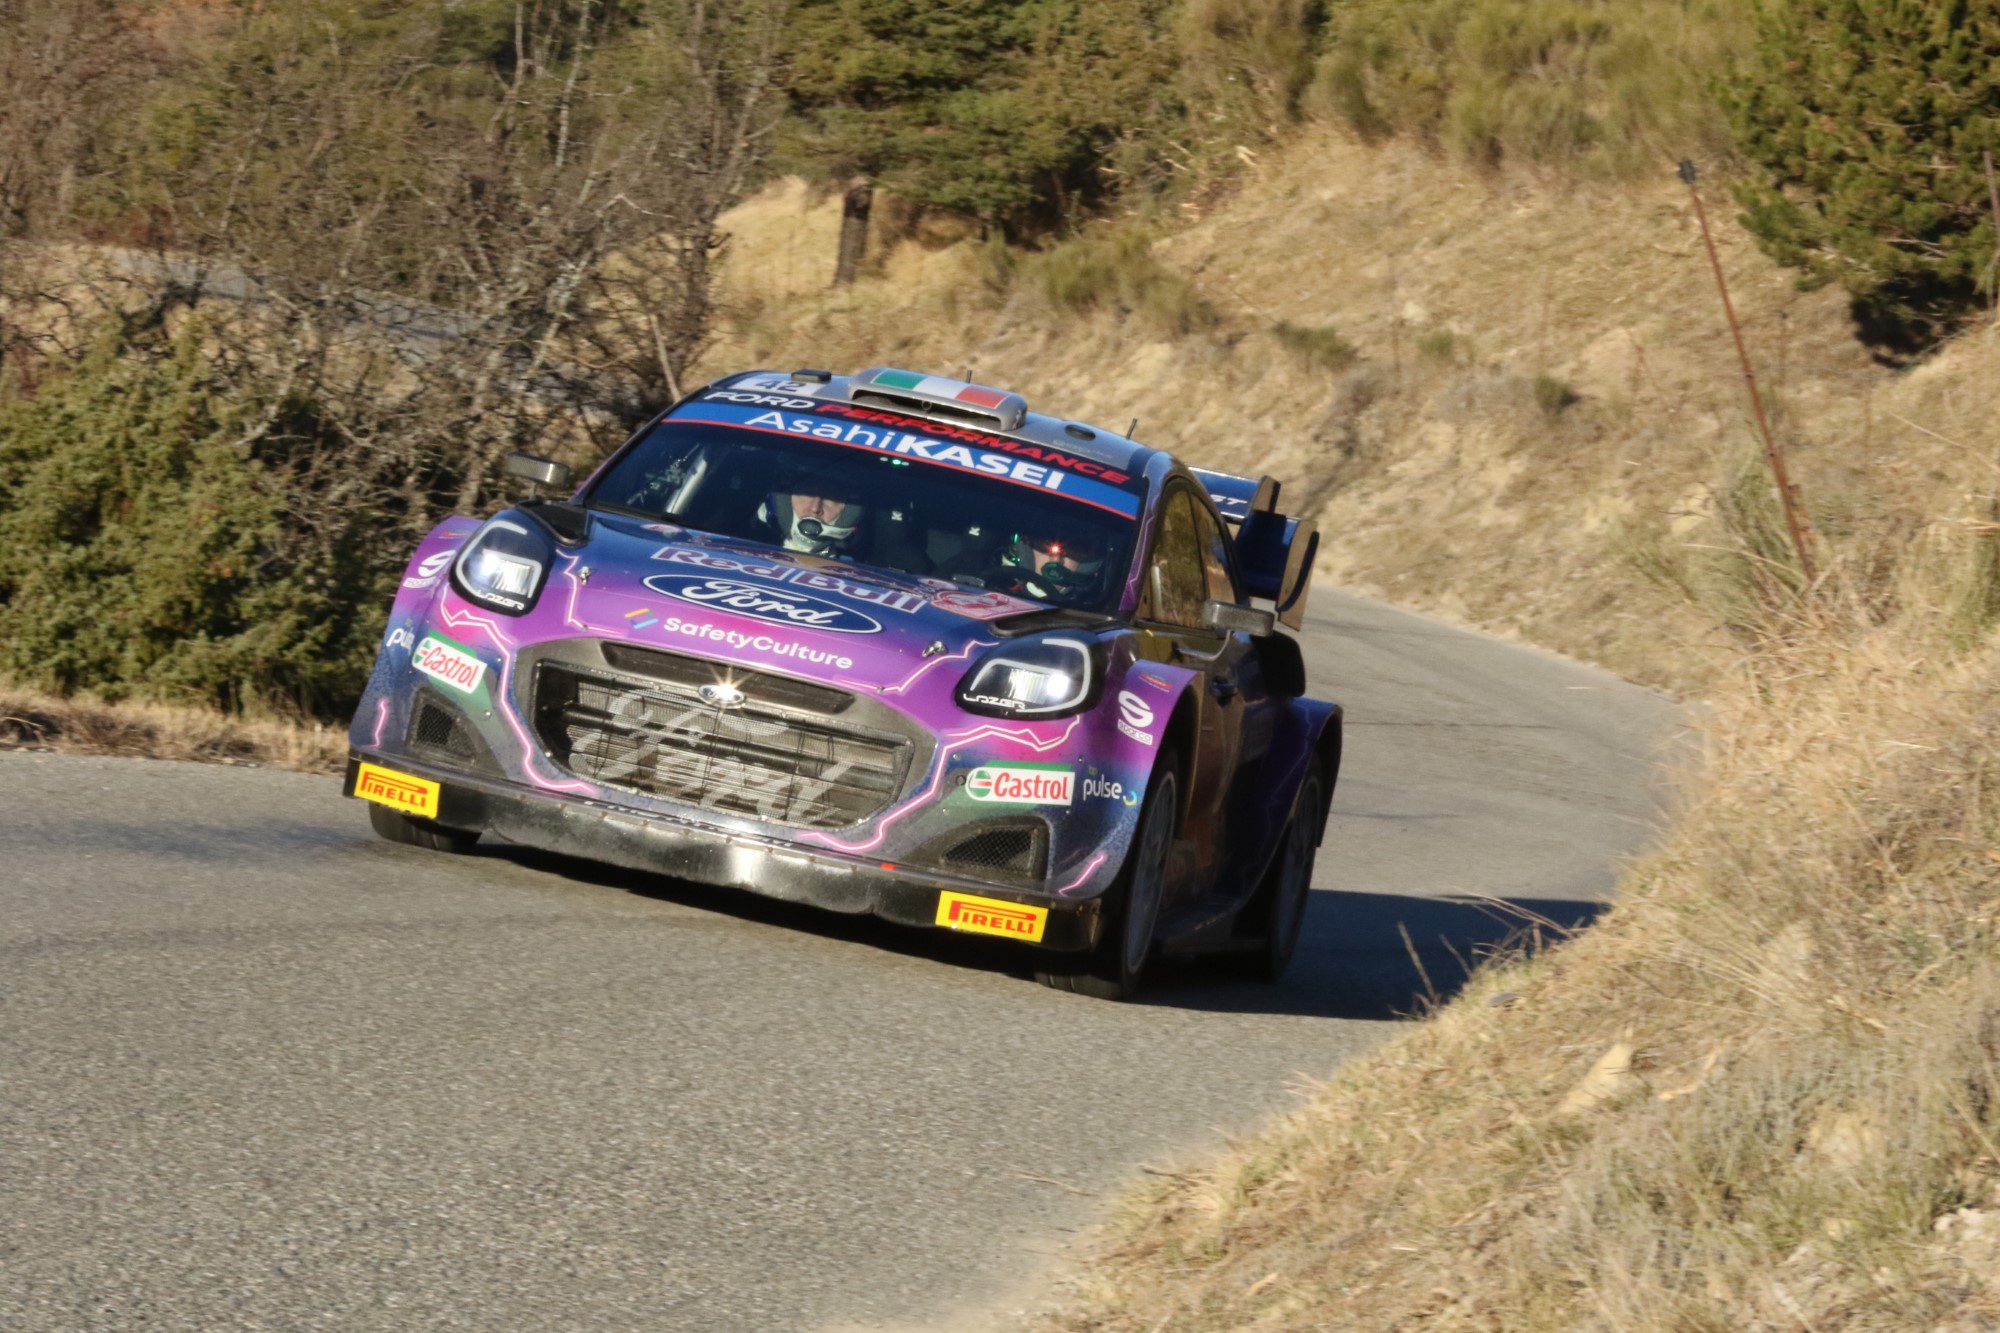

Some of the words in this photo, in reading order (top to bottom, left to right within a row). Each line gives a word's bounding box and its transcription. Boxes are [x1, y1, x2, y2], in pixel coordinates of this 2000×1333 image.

[703, 391, 816, 409] FORD
[816, 404, 1131, 485] PERFORMANCE
[744, 411, 1065, 491] AsahiKASEI
[650, 546, 797, 581] Red
[789, 570, 928, 614] Bull
[681, 581, 843, 624] Ford
[663, 617, 853, 670] SafetyCulture
[423, 646, 479, 688] Castrol
[360, 771, 428, 808] PIRELLI
[994, 772, 1068, 800] Castrol
[1082, 773, 1123, 801] pulse
[948, 900, 1037, 934] PIRELLI
